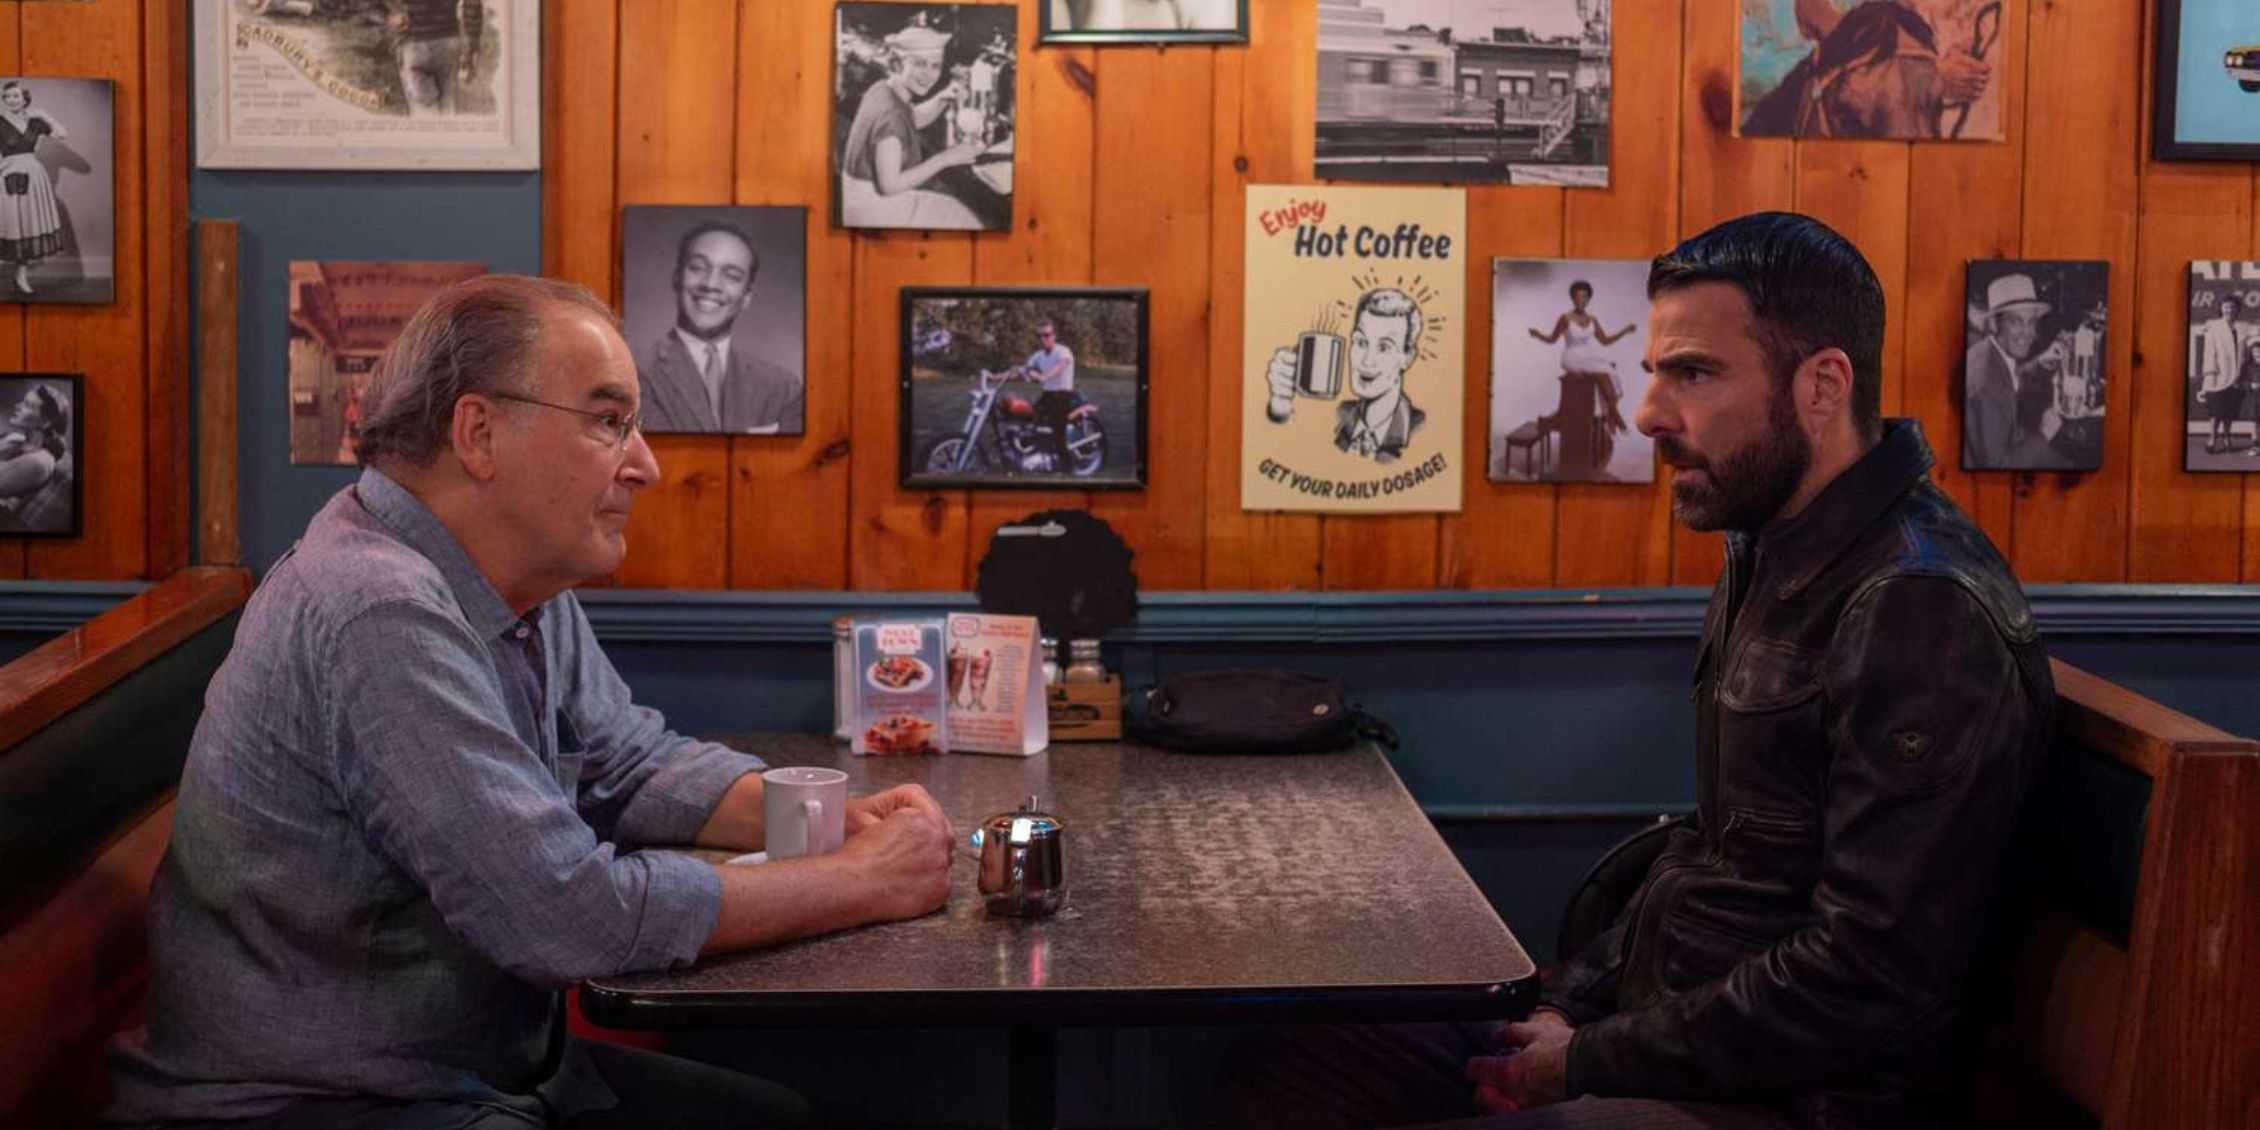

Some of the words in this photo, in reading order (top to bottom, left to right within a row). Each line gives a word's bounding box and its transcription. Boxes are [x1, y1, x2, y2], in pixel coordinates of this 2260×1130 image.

[1259, 197, 1327, 237] Enjoy
[1295, 224, 1348, 258] Hot
[1354, 223, 1452, 259] Coffee
[1258, 458, 1290, 484] GET
[1289, 471, 1334, 498] YOUR
[1334, 480, 1380, 499] DAILY
[1382, 452, 1449, 494] DOSAGE!
